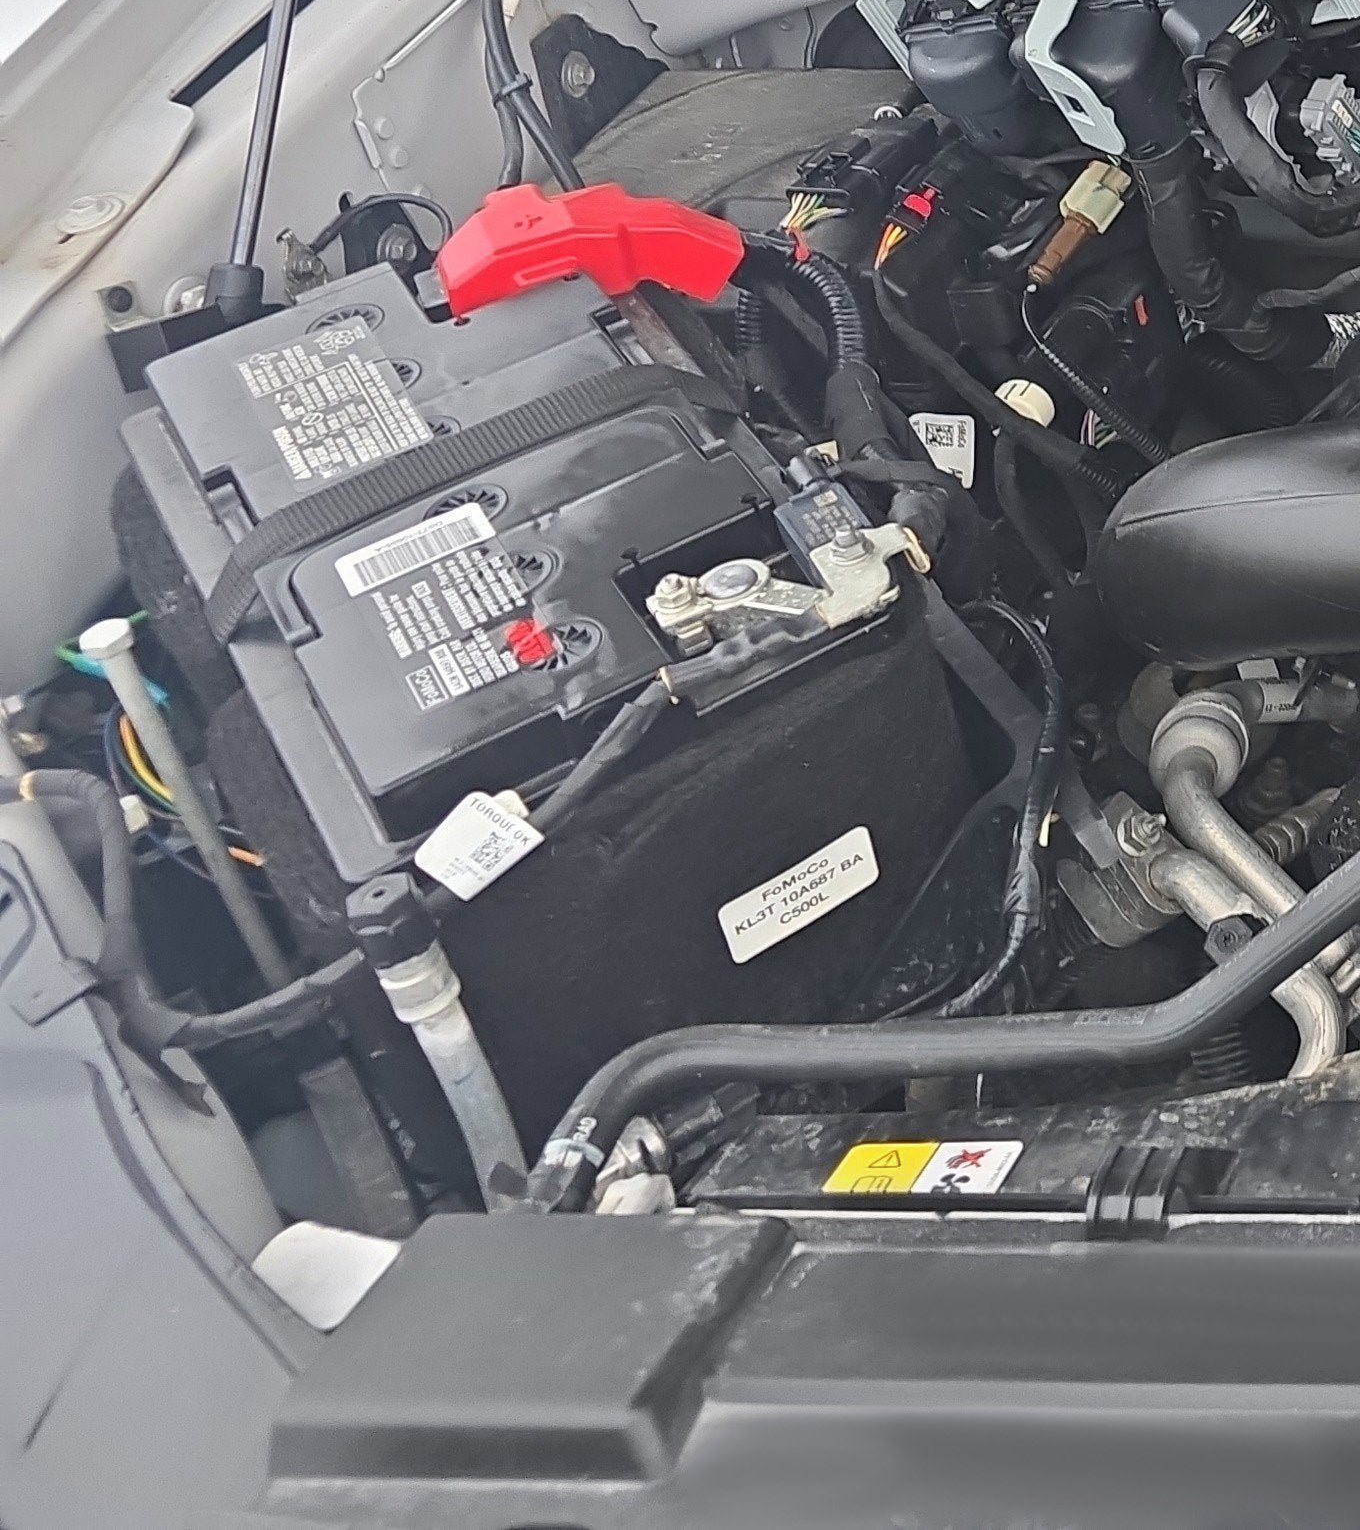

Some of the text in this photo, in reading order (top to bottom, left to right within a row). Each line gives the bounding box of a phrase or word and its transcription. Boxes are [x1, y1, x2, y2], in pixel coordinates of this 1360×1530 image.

[468, 797, 532, 846] TORQUE OK
[734, 853, 864, 936] KL3T 10A687 BA
[761, 858, 829, 902] FoMoCo
[779, 894, 830, 925] C500L
